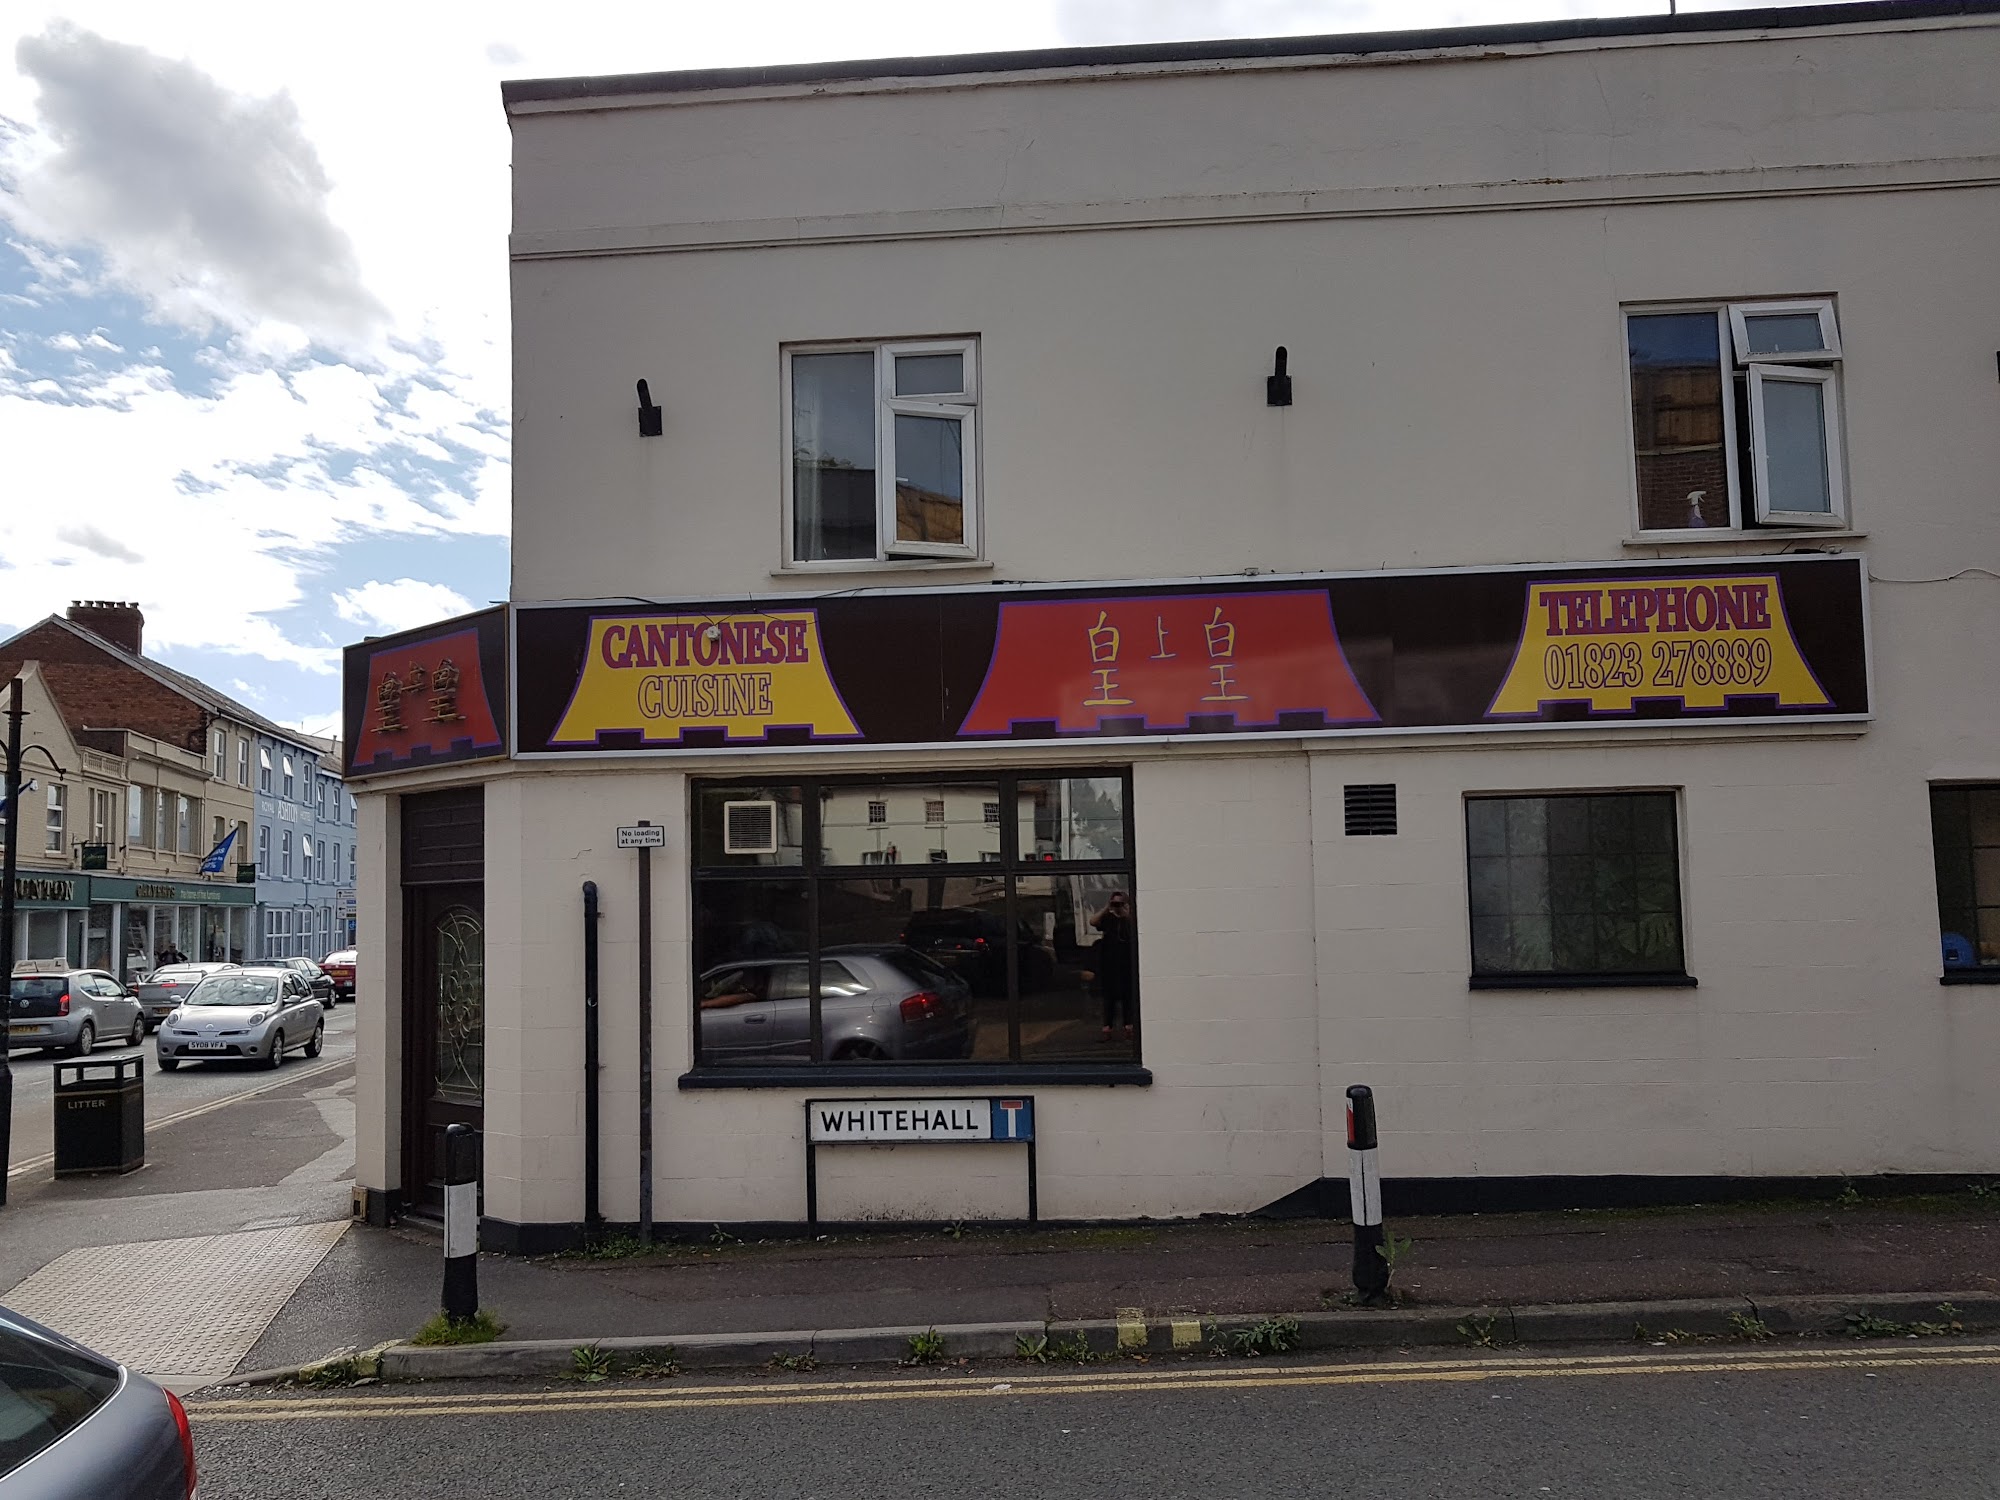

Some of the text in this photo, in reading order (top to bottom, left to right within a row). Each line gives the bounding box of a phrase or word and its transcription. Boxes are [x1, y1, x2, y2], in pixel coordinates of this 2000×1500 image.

[1540, 584, 1771, 636] TELEPHONE
[602, 620, 808, 669] CANTONESE
[1544, 638, 1771, 690] 01823 278889
[638, 672, 773, 718] CUISINE
[277, 799, 298, 822] ASHTON
[634, 829, 660, 837] loading
[191, 1041, 224, 1049] SY08 VFA
[68, 1099, 106, 1109] LITTER
[821, 1109, 978, 1131] WHITEHALL
